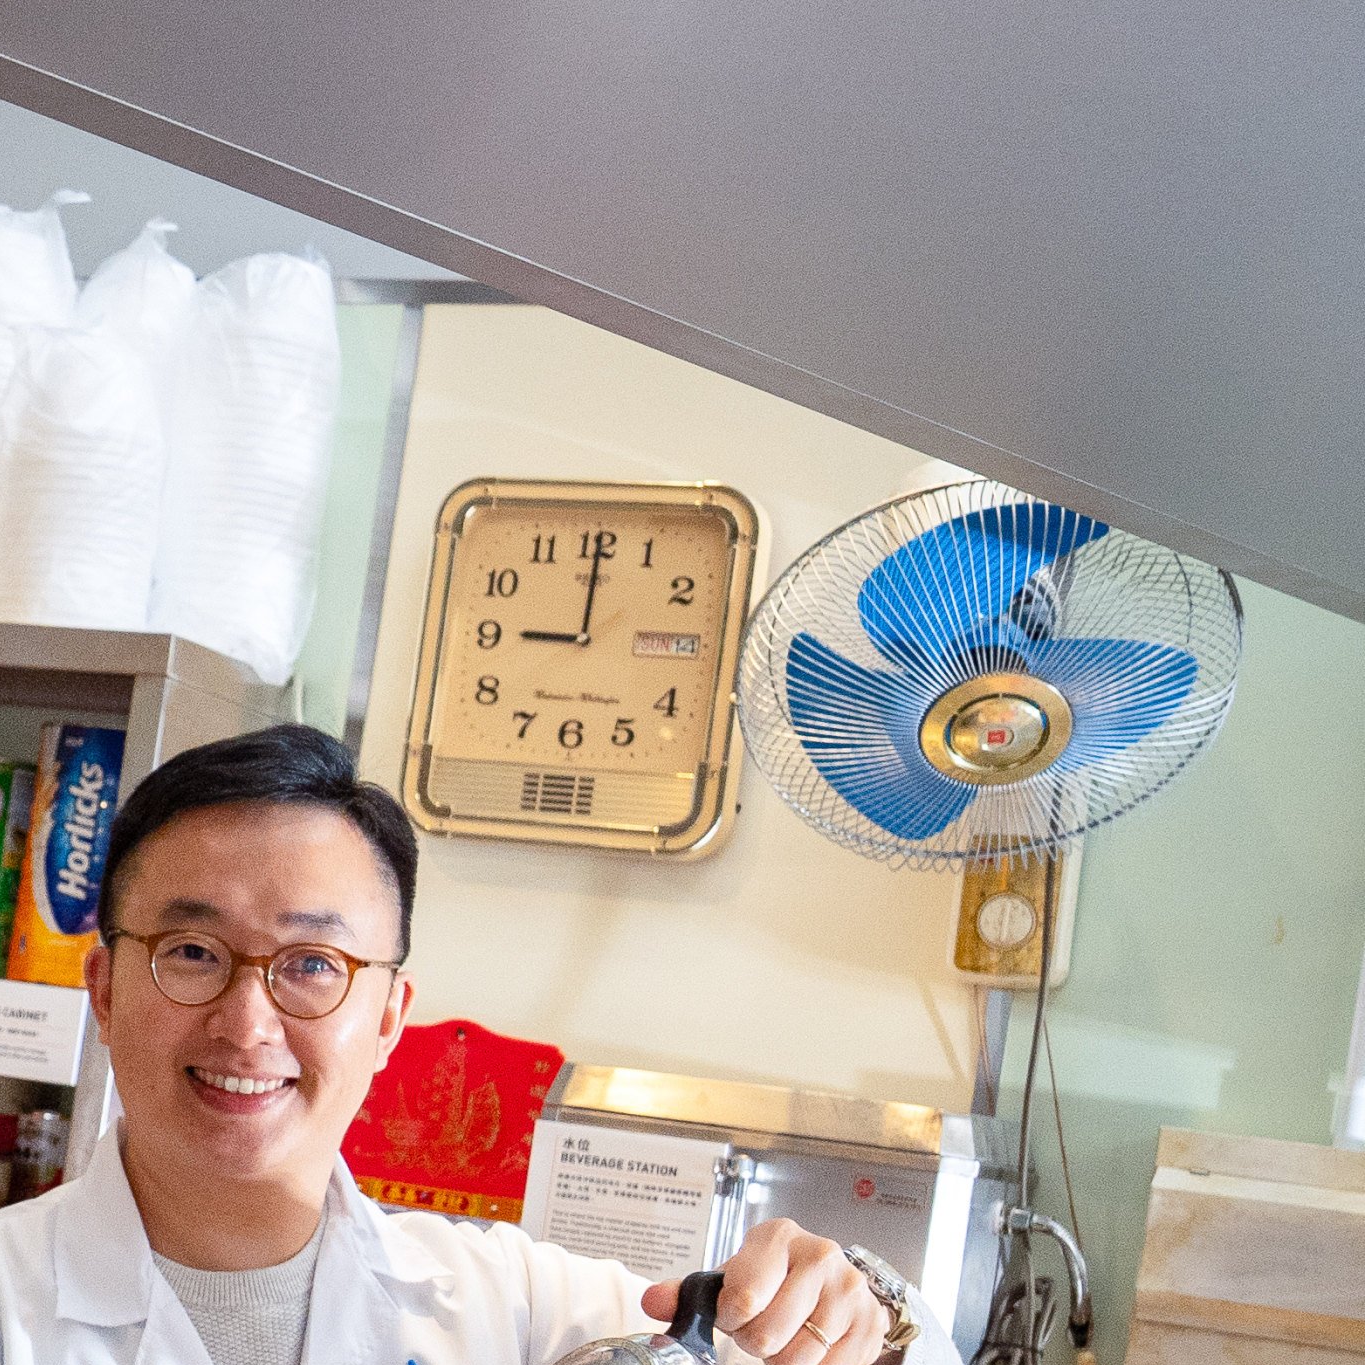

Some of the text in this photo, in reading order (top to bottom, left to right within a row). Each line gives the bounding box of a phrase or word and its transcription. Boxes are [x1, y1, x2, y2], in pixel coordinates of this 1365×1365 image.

[529, 533, 557, 564] 11
[578, 530, 617, 559] 12
[639, 538, 654, 569] 1
[484, 567, 519, 598] 10
[668, 575, 695, 606] 2
[477, 619, 502, 649] 9
[475, 674, 500, 705] 8
[652, 687, 678, 718] 4
[512, 710, 538, 739] 7
[557, 719, 584, 749] 6
[610, 718, 635, 747] 5
[56, 761, 105, 900] Horlicks
[563, 1137, 591, 1151] 水位
[560, 1152, 678, 1177] BEVERAGE STATION
